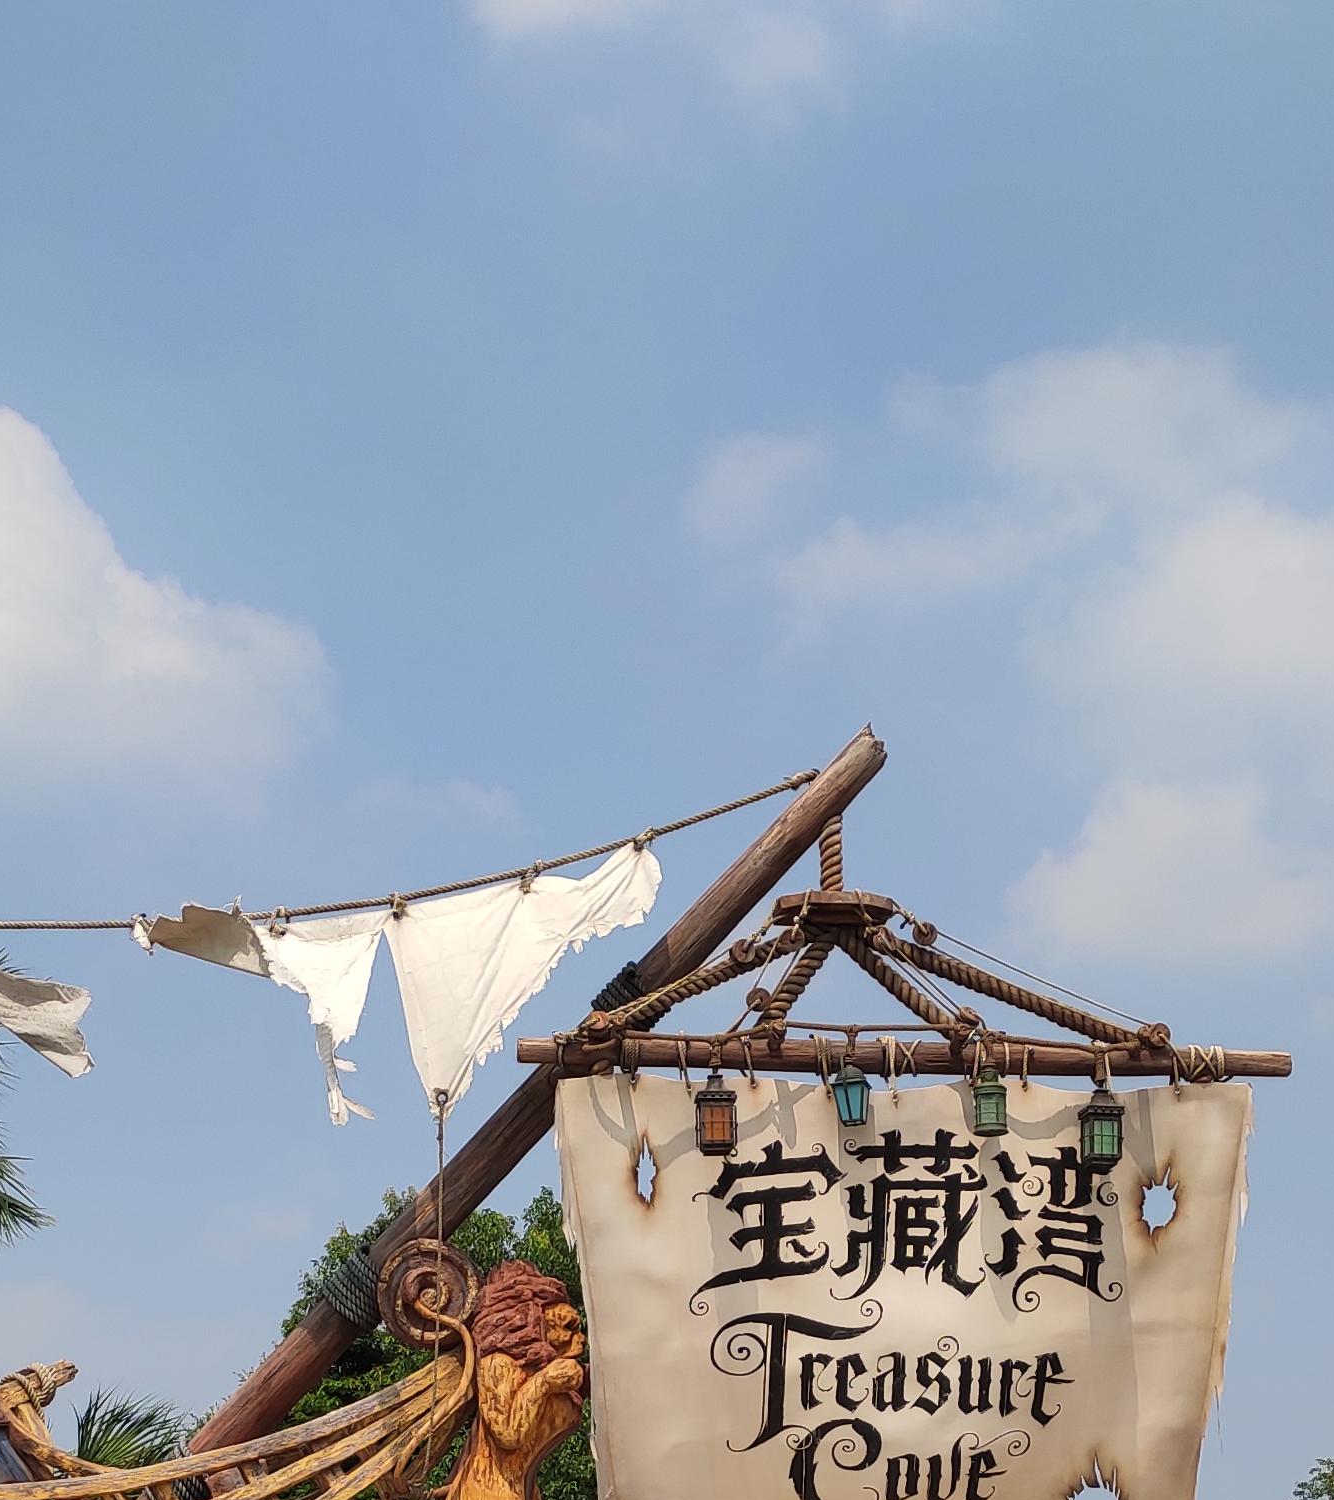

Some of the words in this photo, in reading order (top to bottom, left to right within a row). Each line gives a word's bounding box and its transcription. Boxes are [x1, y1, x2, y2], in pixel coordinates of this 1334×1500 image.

[689, 1128, 1124, 1315] 宝藏湾
[709, 1299, 1075, 1453] Treasure
